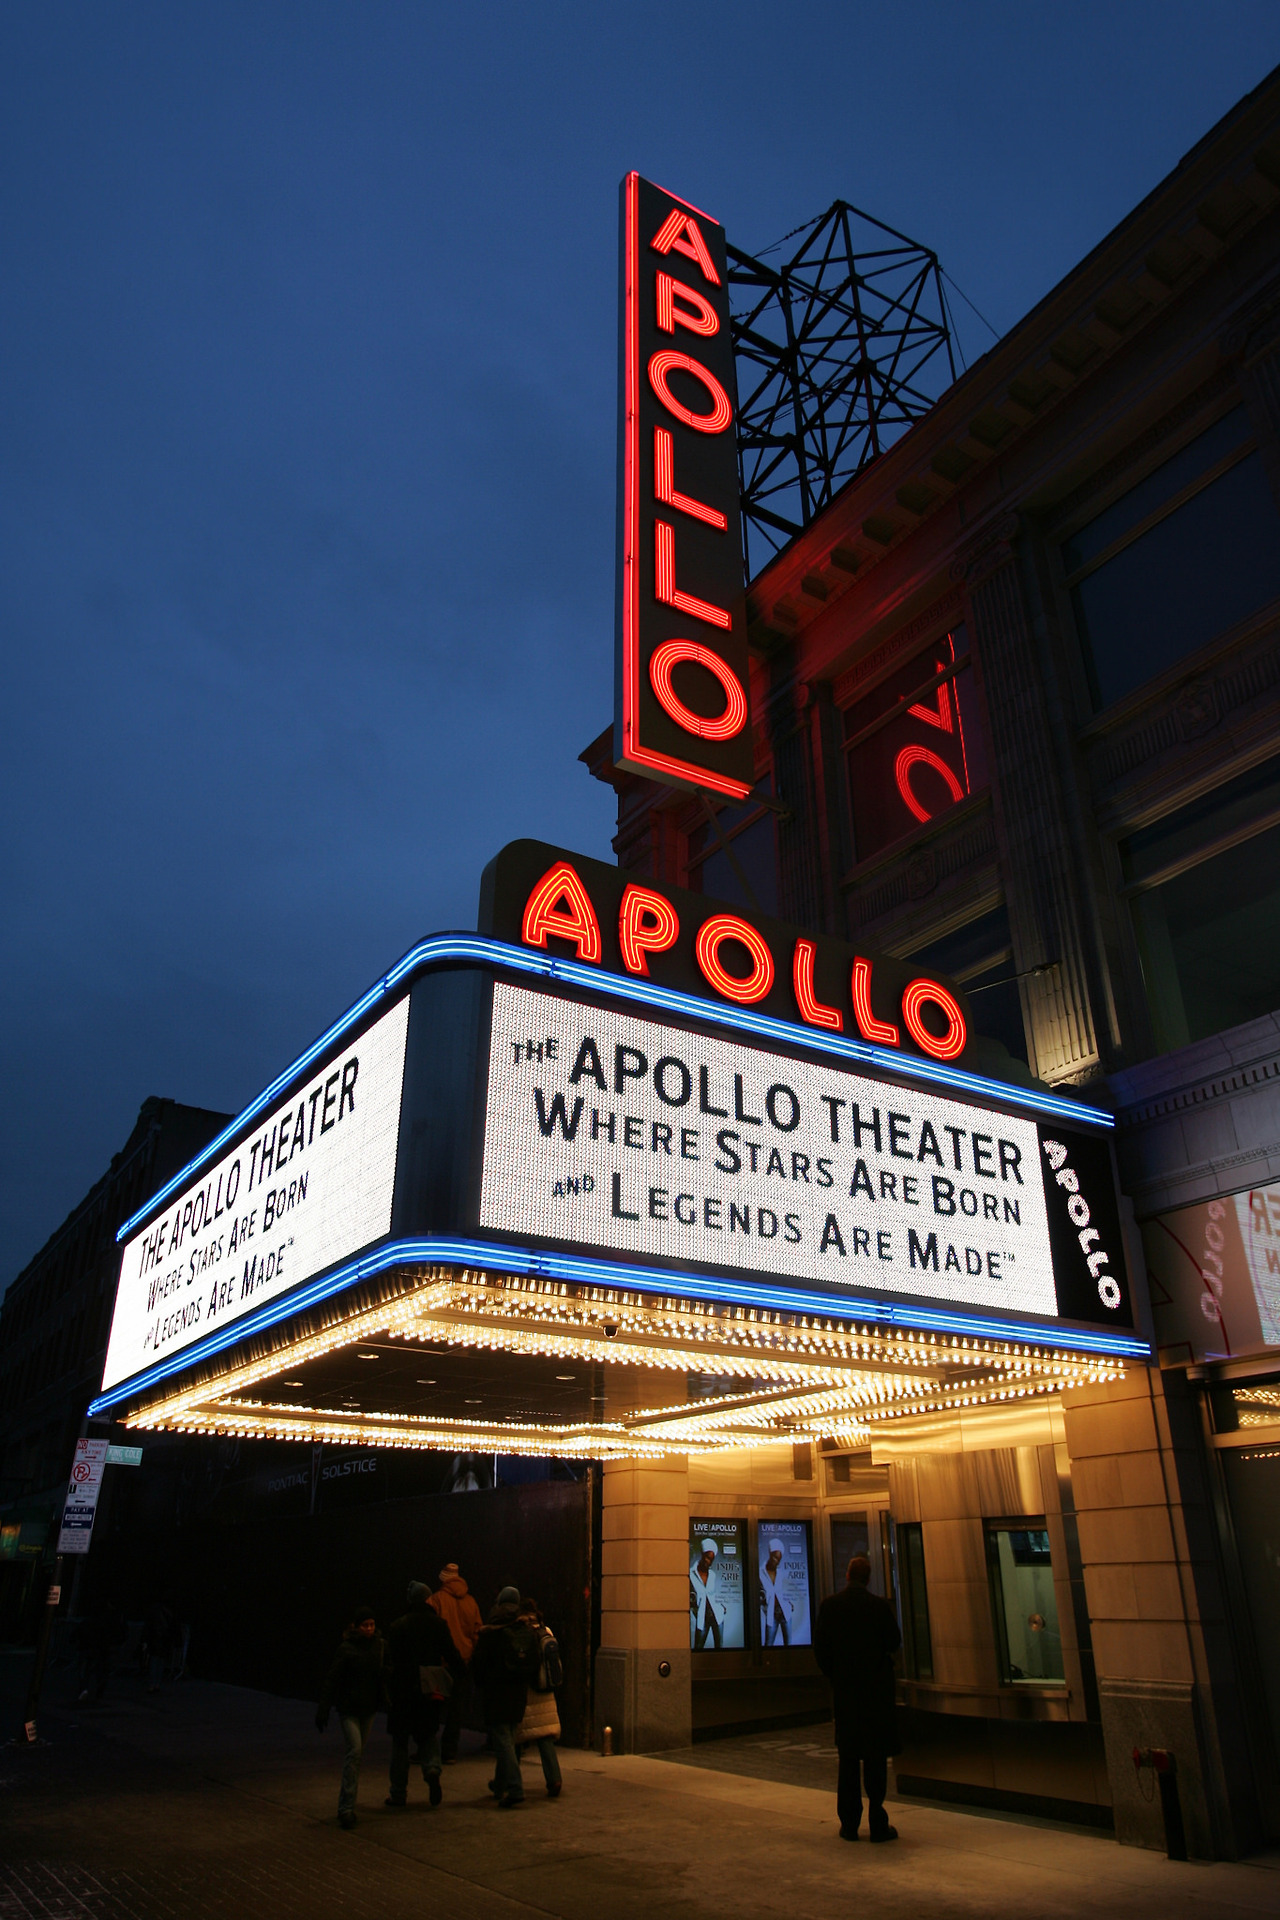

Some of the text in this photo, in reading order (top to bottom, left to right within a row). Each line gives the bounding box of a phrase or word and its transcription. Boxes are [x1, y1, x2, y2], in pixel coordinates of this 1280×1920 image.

[649, 207, 748, 742] APOLLO
[521, 860, 967, 1061] APOLLO
[138, 1056, 359, 1279] THE APOLLO THEATER
[511, 1035, 1024, 1185] THE APOLLO THEATER
[533, 1087, 1021, 1226] WHERE STARS ARE BORN
[147, 1170, 309, 1313] WHERE STARS ARE BORN
[553, 1174, 595, 1197] AND
[612, 1172, 802, 1243] LEGENDS
[820, 1212, 893, 1261] ARE
[1043, 1139, 1121, 1310] APOLLO
[154, 1296, 203, 1350] LEGENDS
[207, 1276, 236, 1319] ARE
[78, 1440, 87, 1448] NO
[125, 1449, 140, 1459] COLE
[267, 1458, 377, 1493] PONTIAC SOLSTICE
[693, 1523, 737, 1532] LIVE APOLLO
